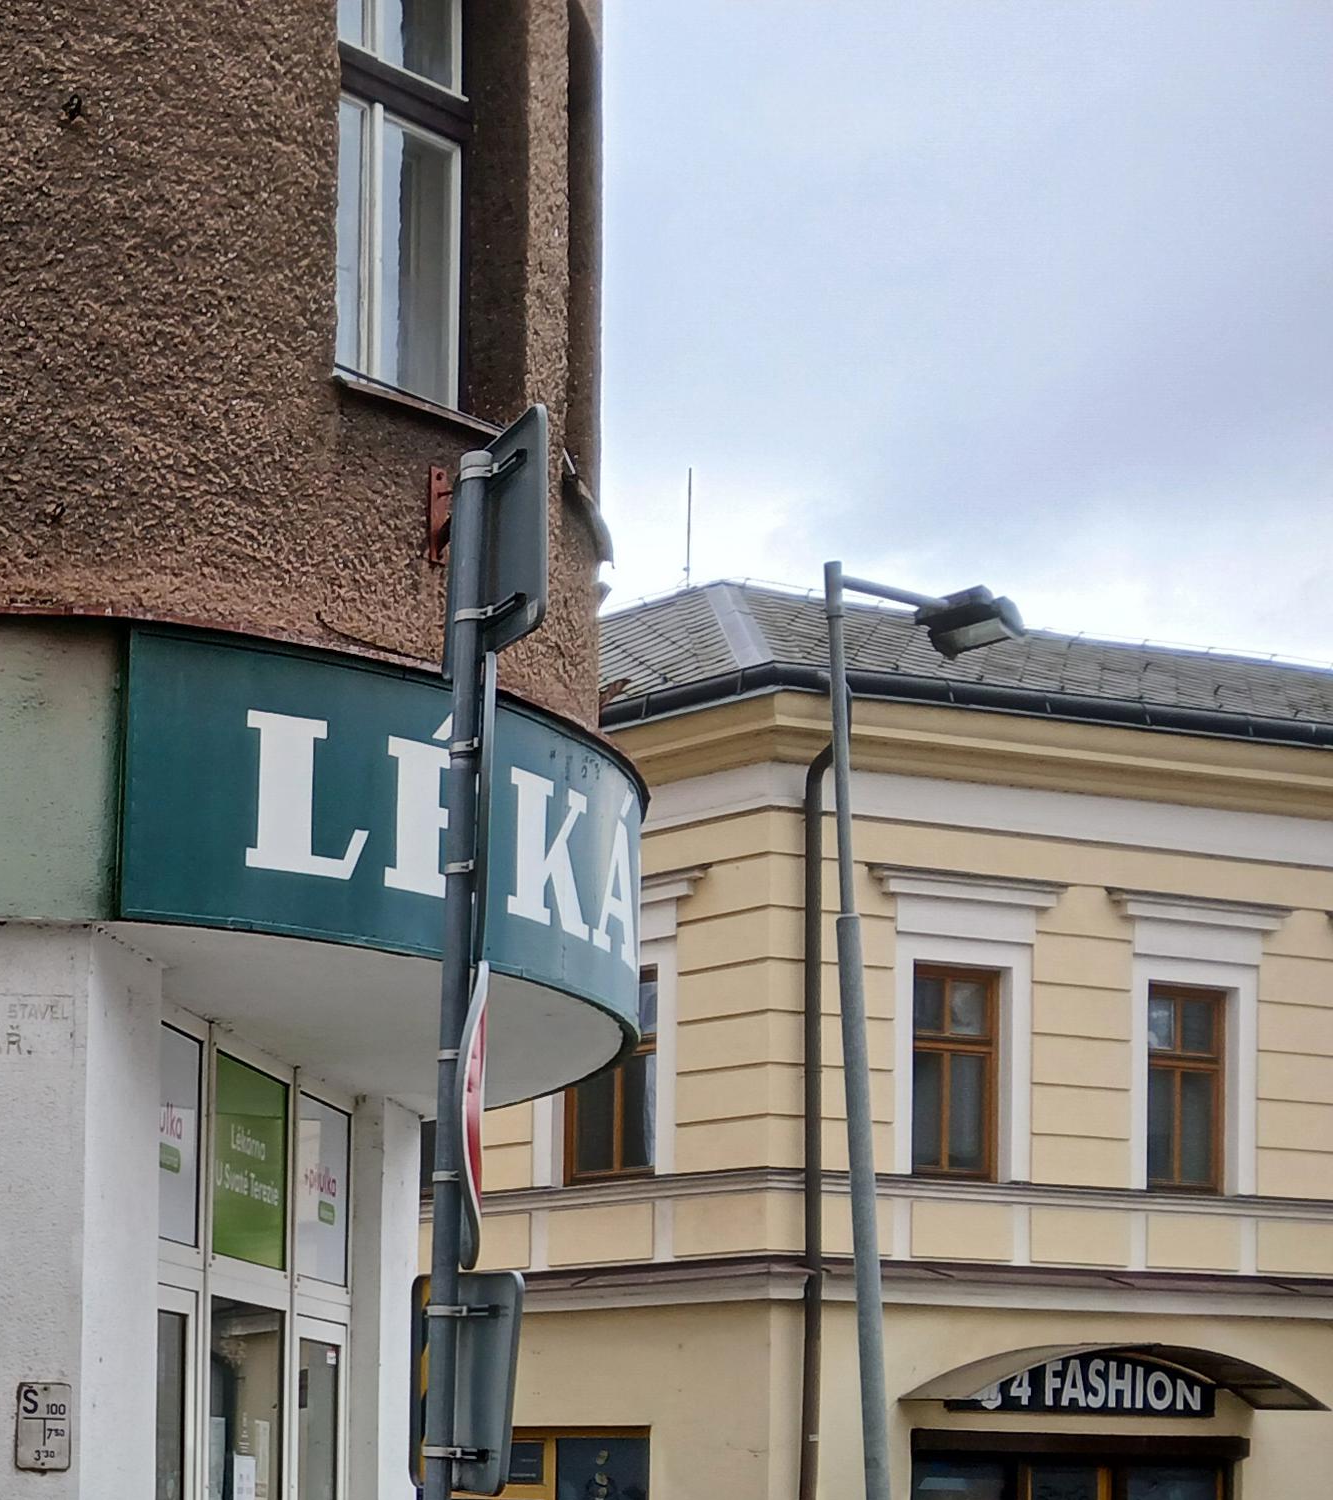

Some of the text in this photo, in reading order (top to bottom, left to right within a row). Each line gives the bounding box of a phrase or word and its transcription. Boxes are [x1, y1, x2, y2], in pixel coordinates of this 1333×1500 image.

[230, 1123, 266, 1161] Lékárna
[250, 1173, 280, 1207] Terezie
[1009, 1358, 1202, 1411] 4 FASHION
[45, 1403, 66, 1416] 100
